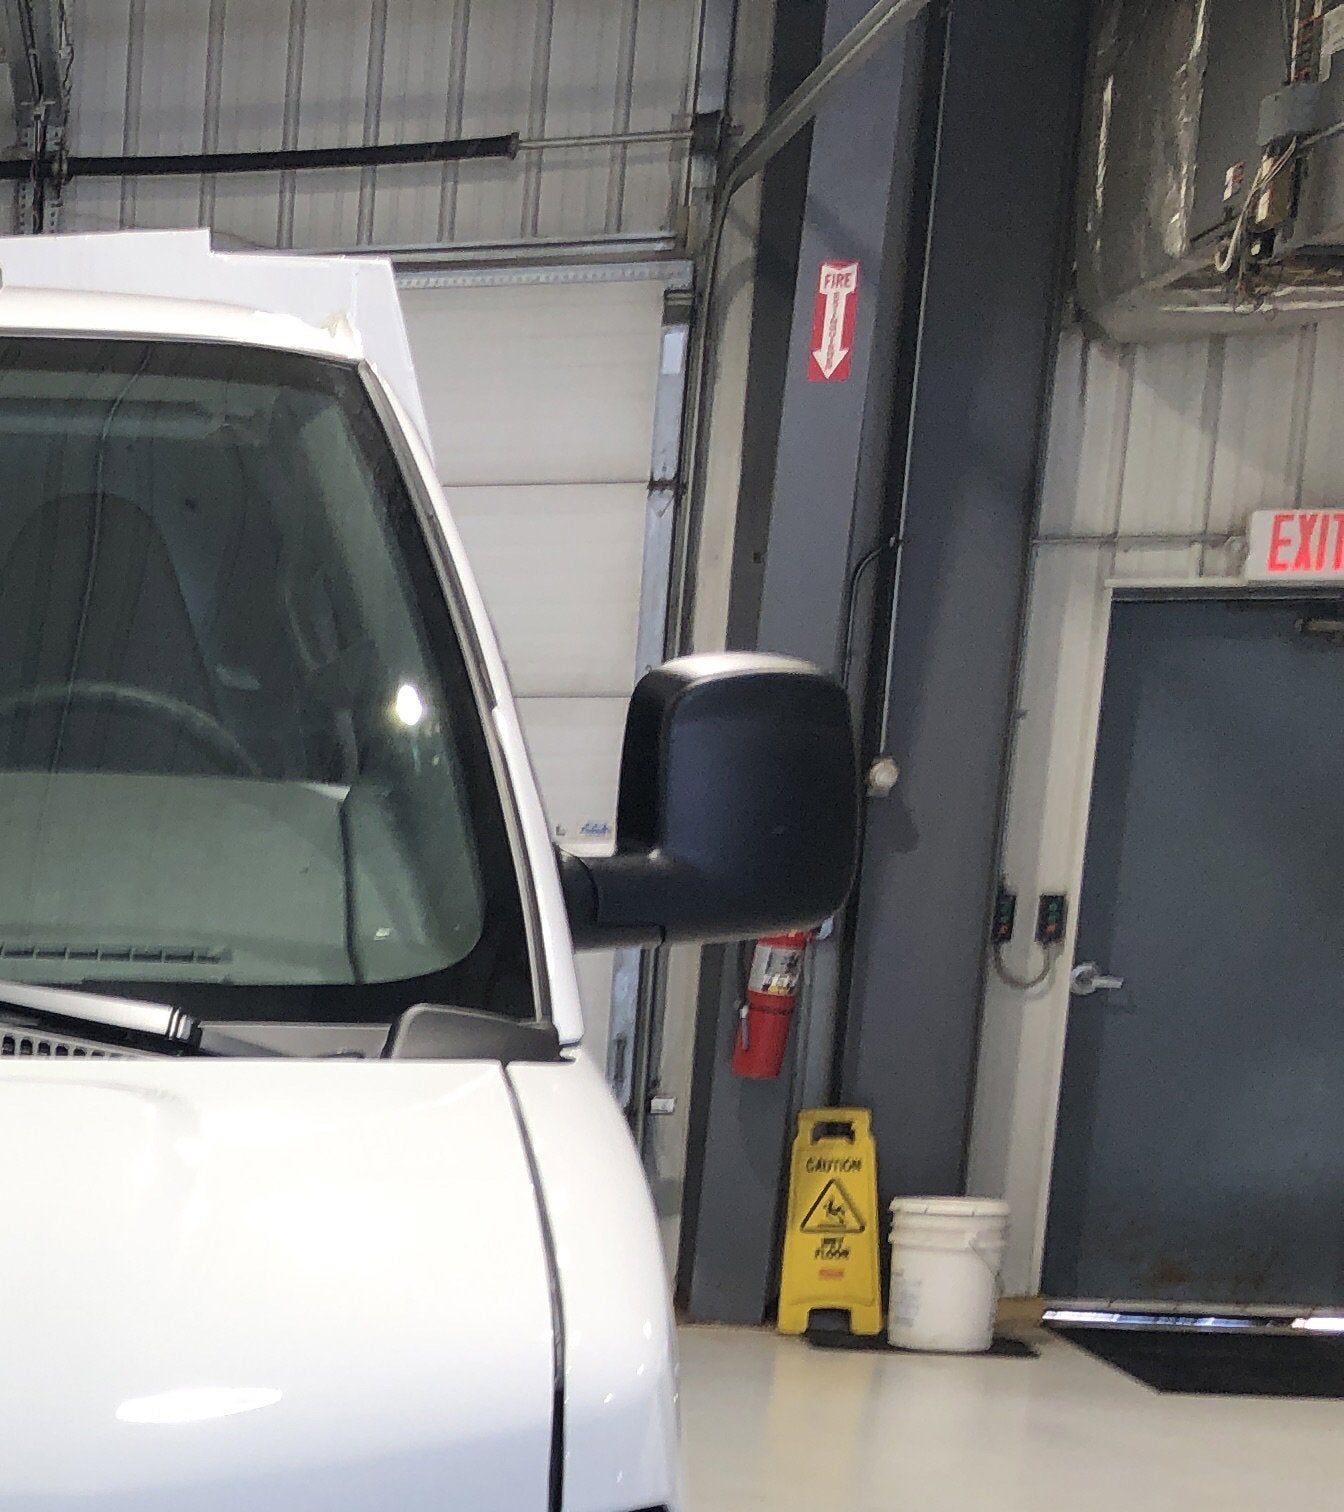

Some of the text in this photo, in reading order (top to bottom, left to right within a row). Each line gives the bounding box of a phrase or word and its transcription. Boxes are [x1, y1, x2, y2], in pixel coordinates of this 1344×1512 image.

[824, 272, 853, 289] FIRE
[1267, 513, 1344, 572] EXIT
[806, 1157, 862, 1173] CAUTION
[814, 1248, 850, 1260] FLOOR
